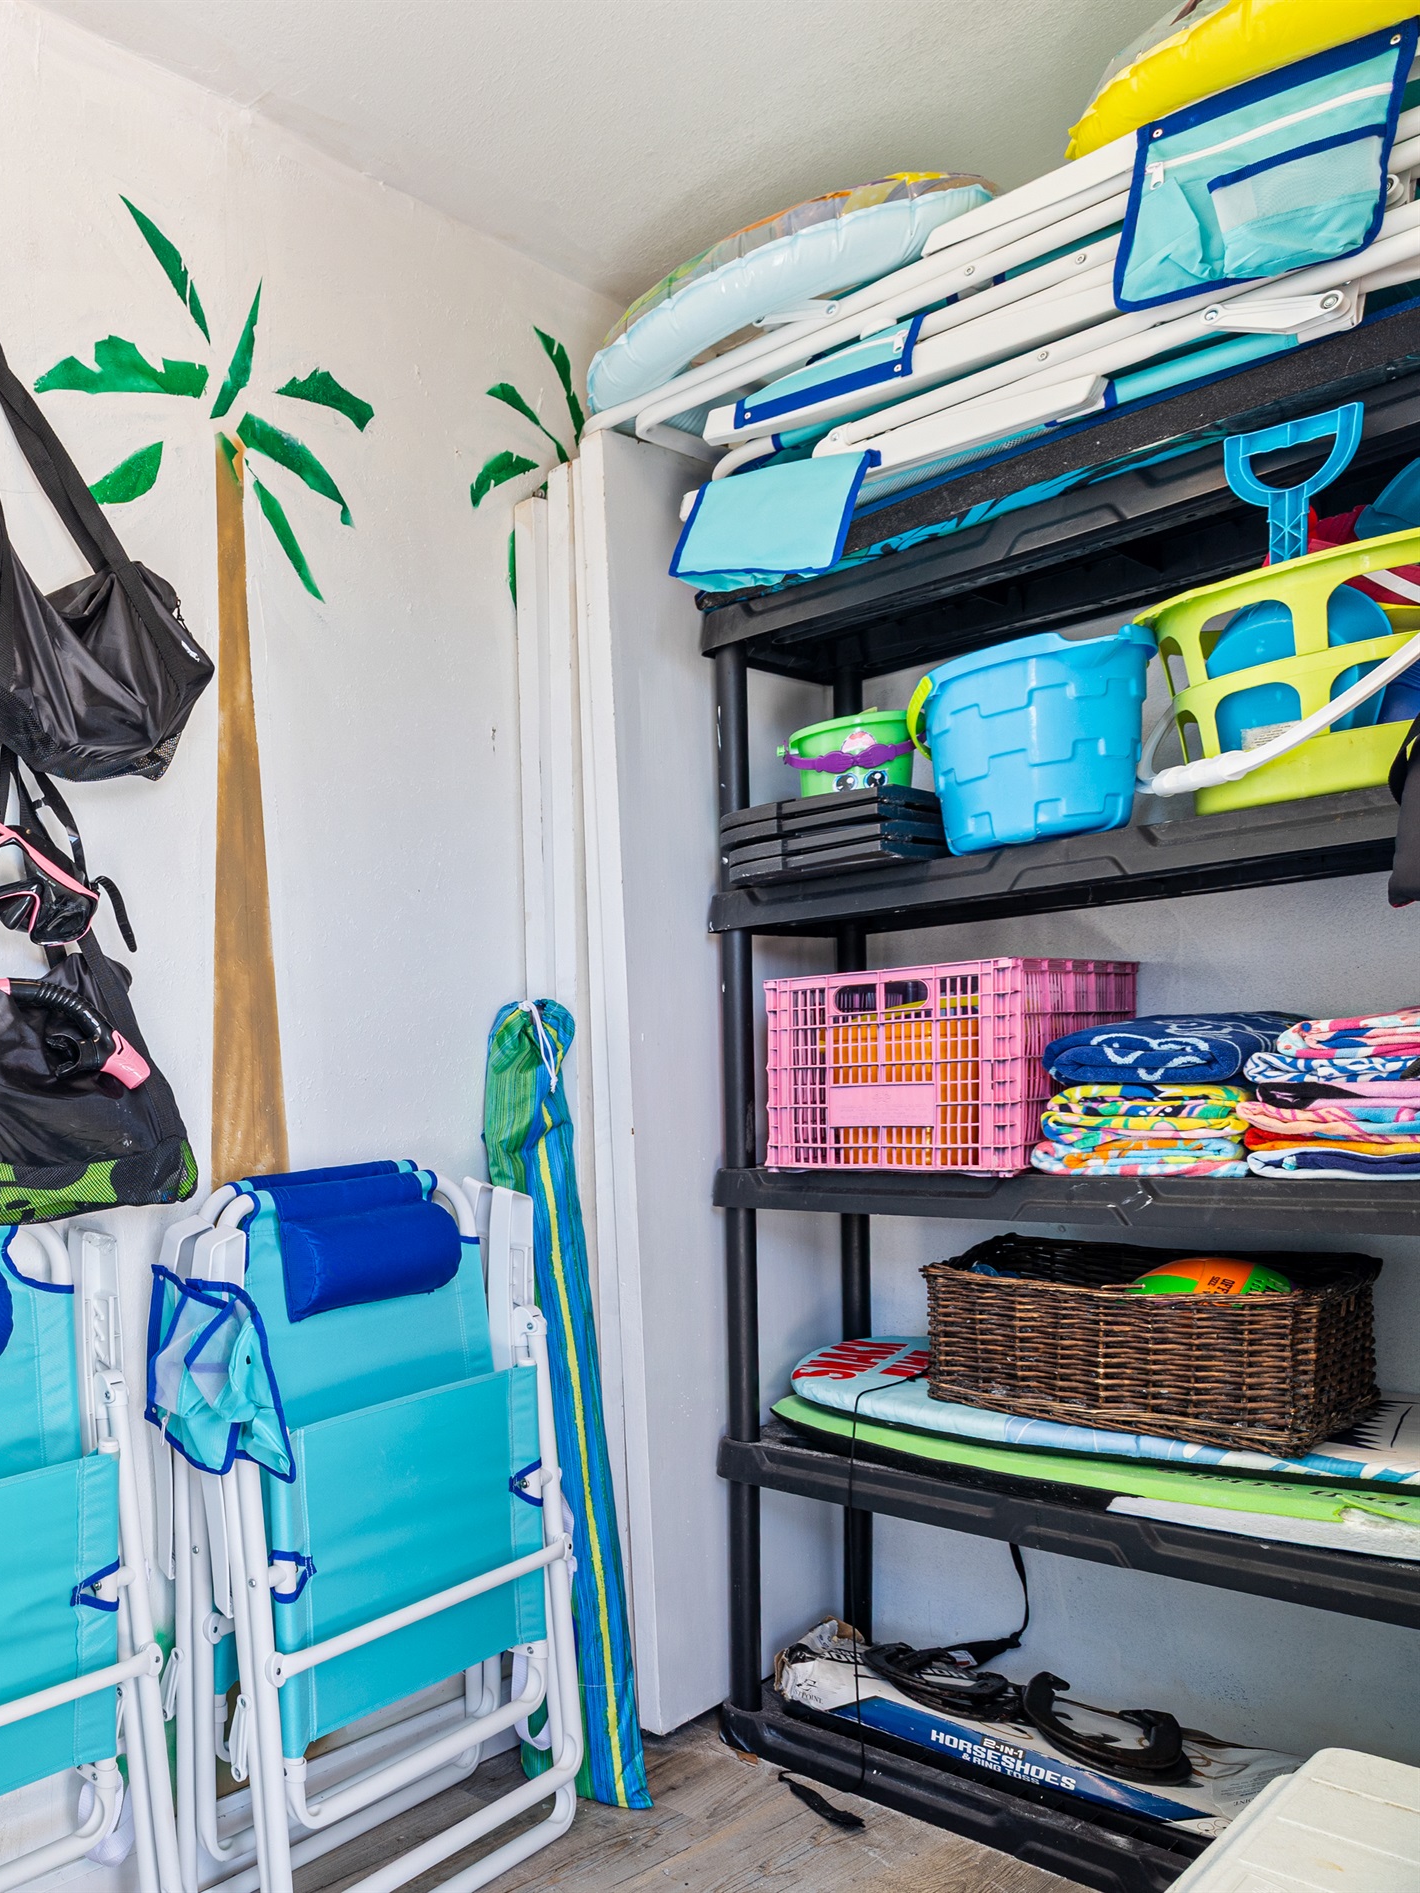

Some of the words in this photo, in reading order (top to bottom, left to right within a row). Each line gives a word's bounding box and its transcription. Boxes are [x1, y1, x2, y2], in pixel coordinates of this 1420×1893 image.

[791, 1339, 909, 1380] SNACK
[930, 1729, 1077, 1791] HORSESHOES
[982, 1737, 1024, 1759] 2-IN-1
[961, 1752, 971, 1762] &
[972, 1756, 1002, 1773] RING
[1005, 1767, 1040, 1785] TOSS
